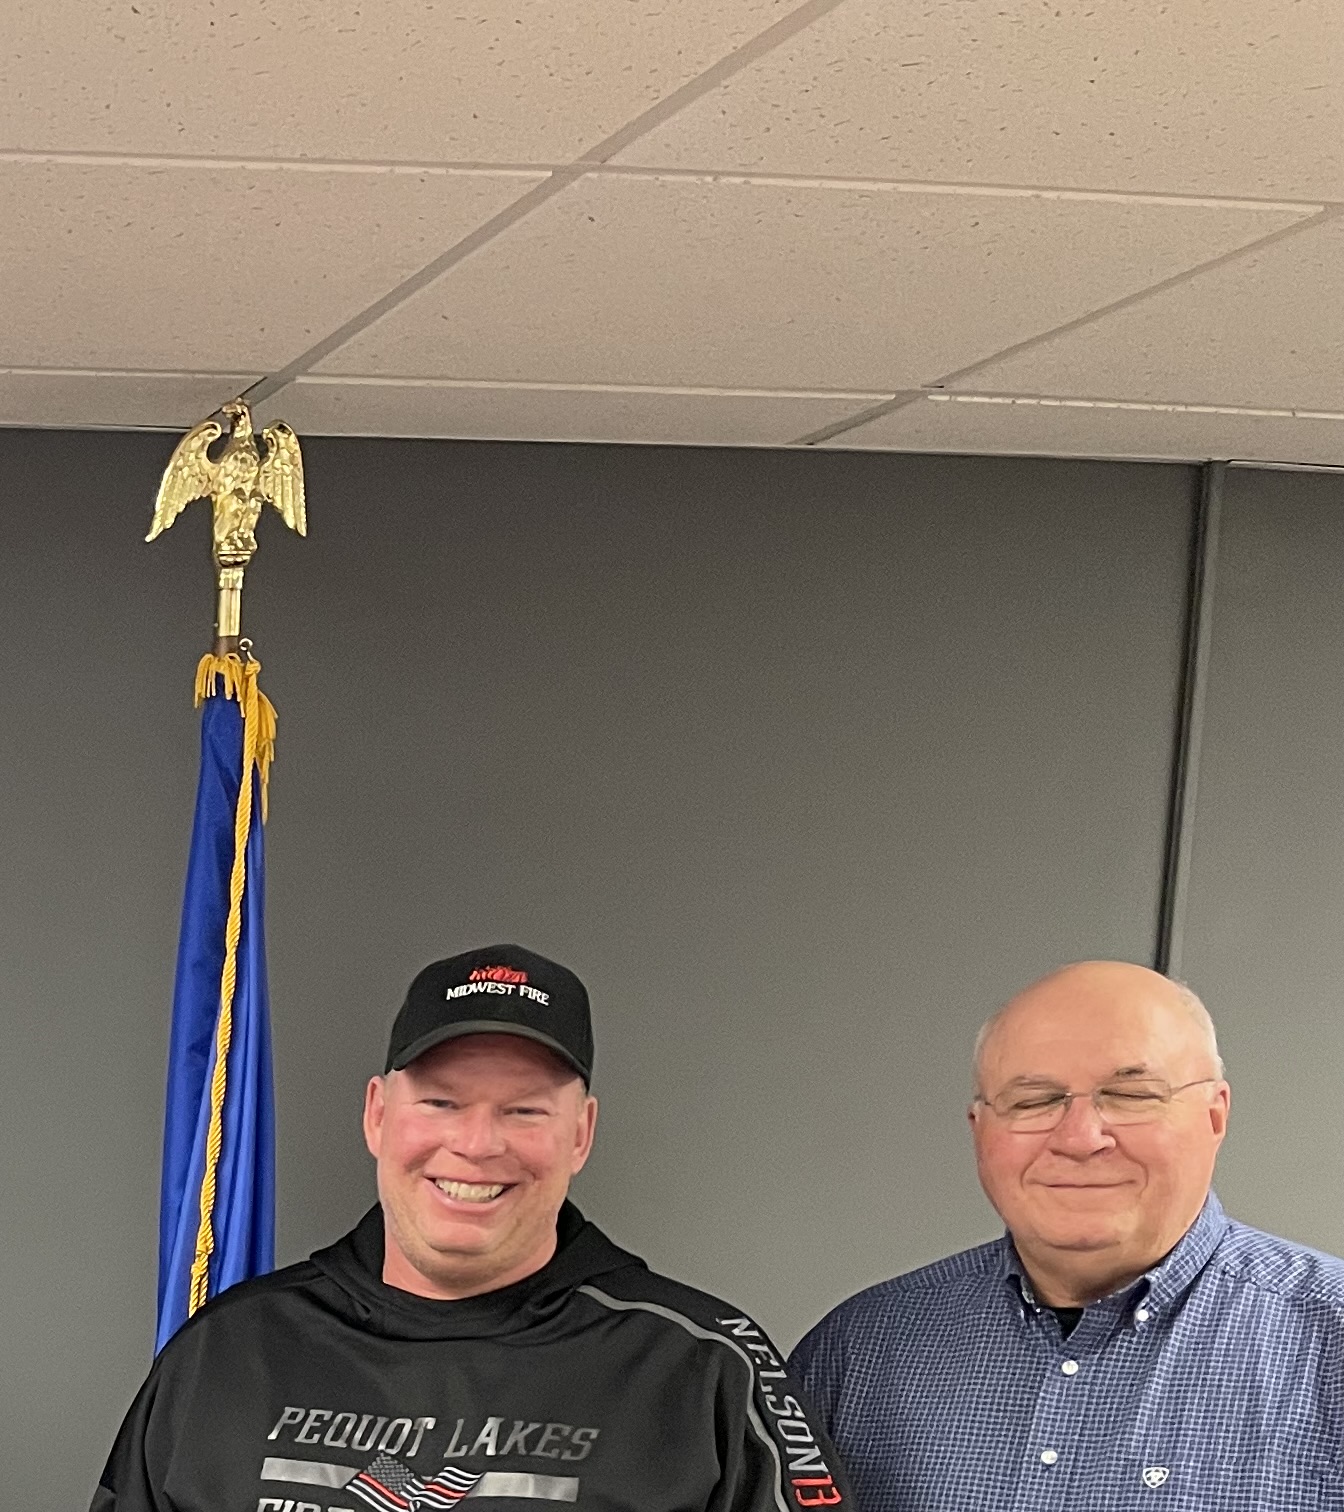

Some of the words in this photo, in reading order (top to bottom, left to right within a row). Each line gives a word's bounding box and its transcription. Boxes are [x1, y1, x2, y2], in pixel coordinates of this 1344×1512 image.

[446, 981, 516, 1000] MIDWEST
[519, 984, 550, 1006] FIRE
[715, 1318, 829, 1472] NELSON
[268, 1406, 436, 1458] PEQUOT
[444, 1417, 600, 1461] LAKES
